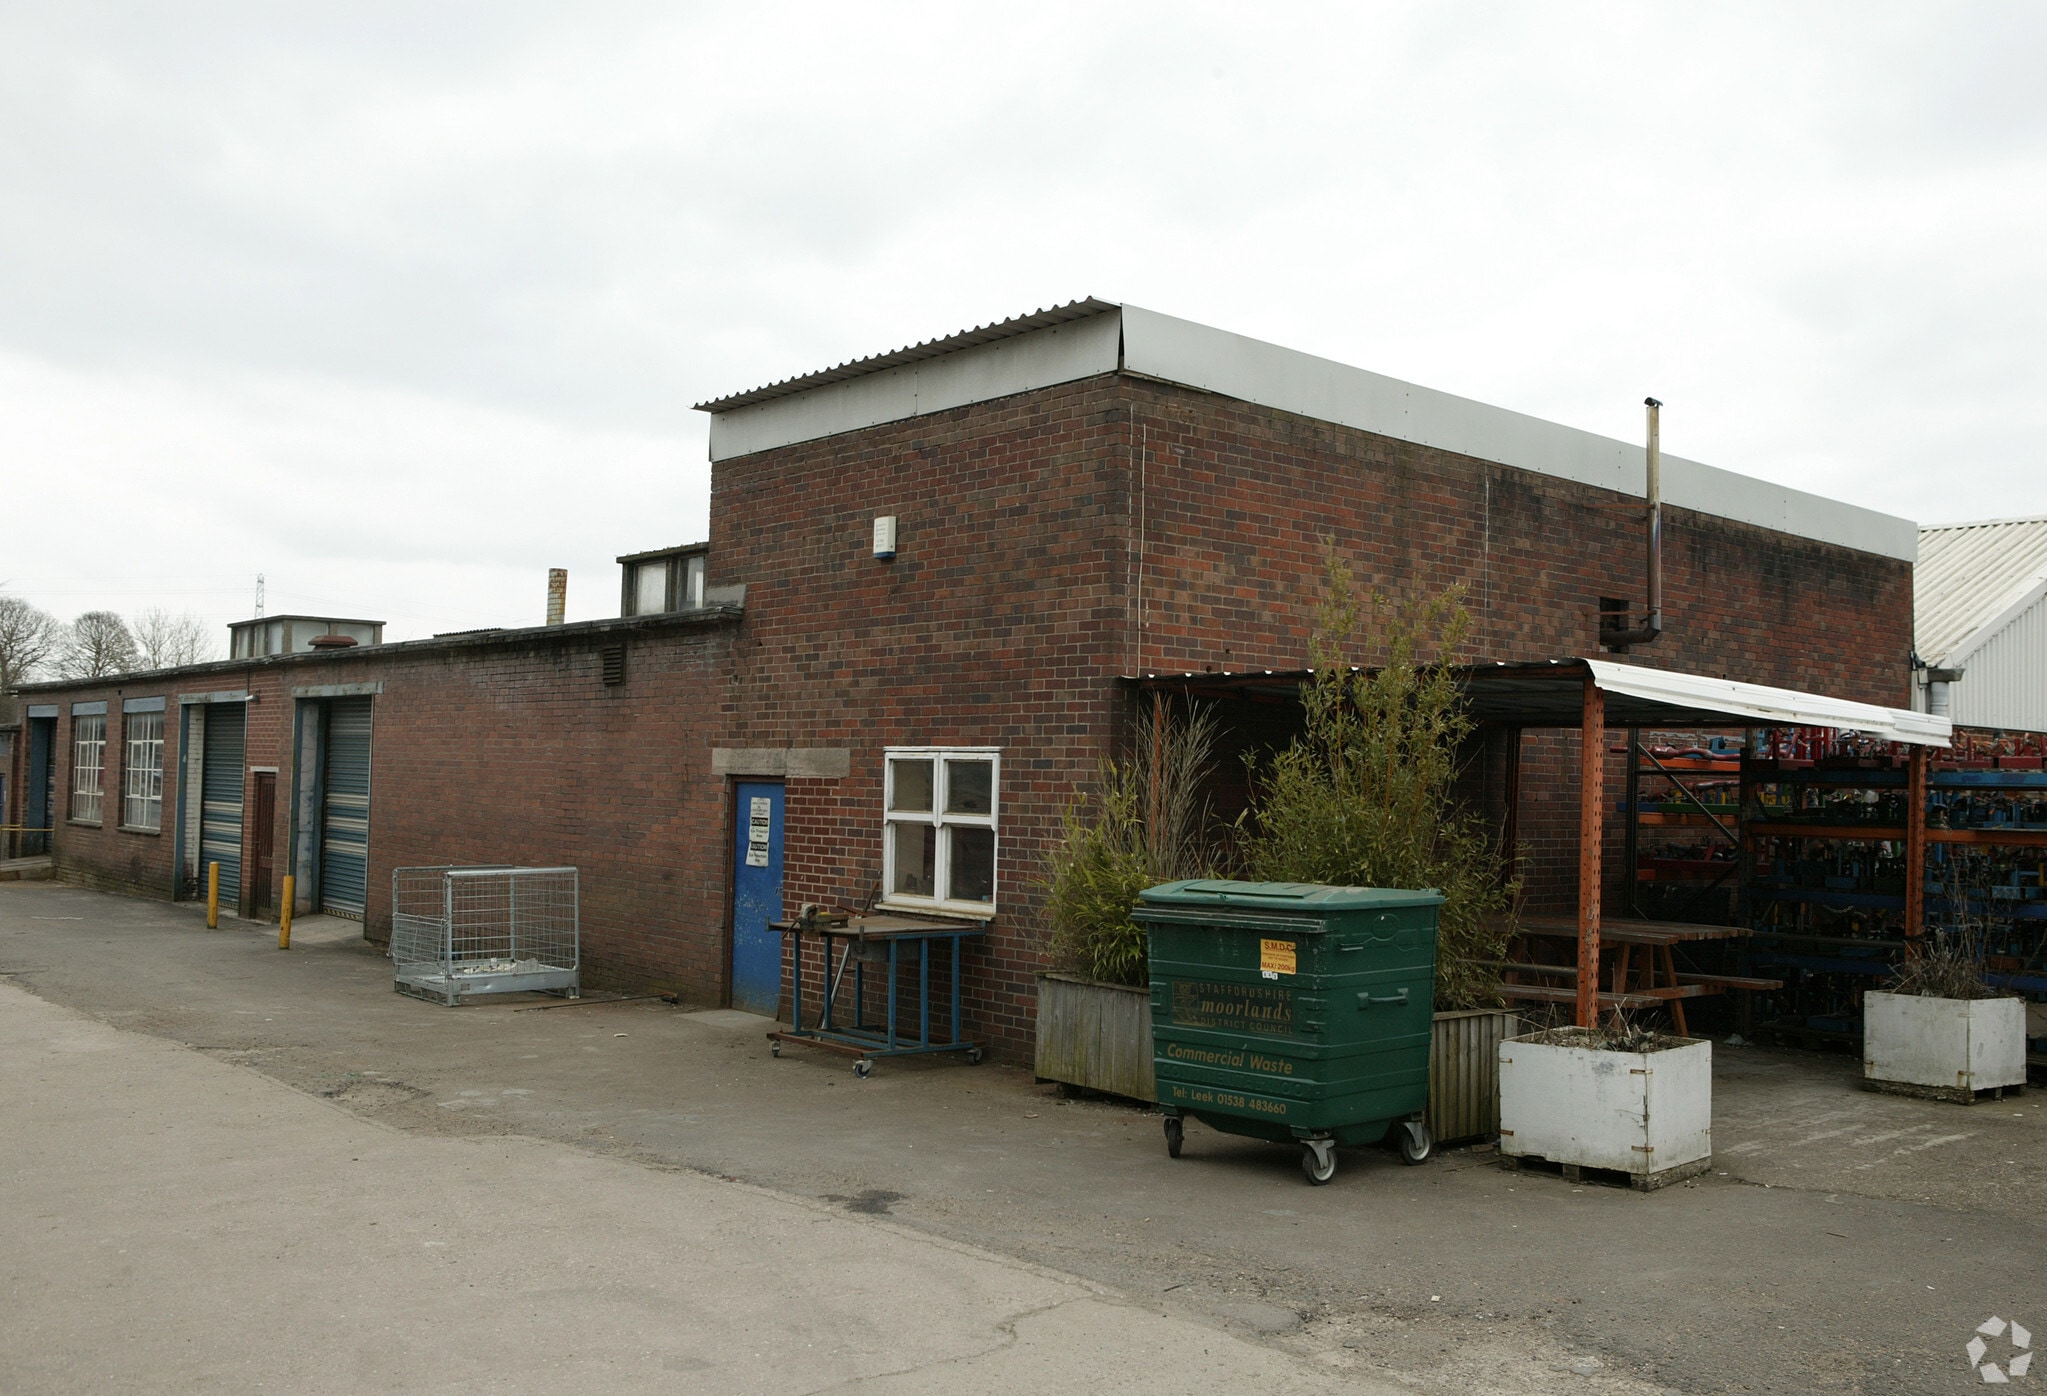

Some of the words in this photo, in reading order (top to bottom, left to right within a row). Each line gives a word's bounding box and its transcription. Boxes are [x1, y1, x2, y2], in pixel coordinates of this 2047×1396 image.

[1199, 983, 1292, 1001] STAFFORDSHIRE
[1201, 1000, 1292, 1021] moorlands
[1200, 1016, 1245, 1029] DISTRICT
[1249, 1022, 1293, 1034] COUNCIL
[1167, 1043, 1245, 1066] Commercial
[1250, 1055, 1293, 1075] Waste
[1172, 1086, 1187, 1098] Tel:
[1191, 1089, 1213, 1102] Leek
[1217, 1093, 1245, 1108] 01538
[1249, 1098, 1287, 1115] 483660
